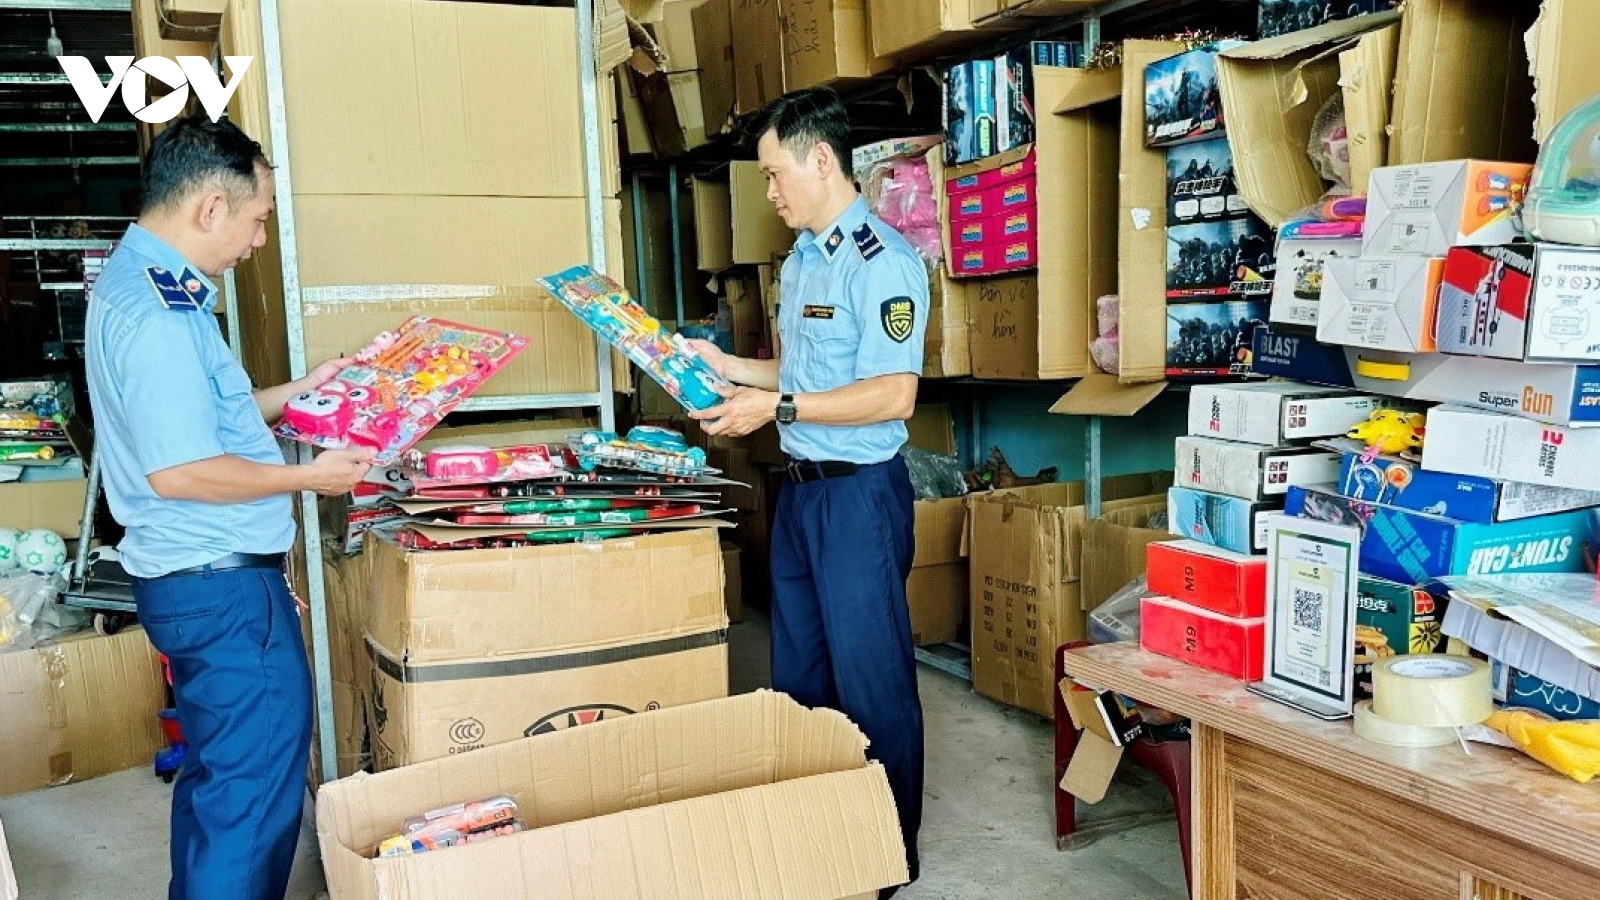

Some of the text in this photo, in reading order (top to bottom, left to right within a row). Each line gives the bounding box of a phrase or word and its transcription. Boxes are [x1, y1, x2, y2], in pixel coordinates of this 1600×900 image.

[891, 302, 911, 311] DMS
[1260, 334, 1299, 359] BLAST
[1479, 391, 1519, 407] Super
[1522, 385, 1553, 416] Gun
[1467, 547, 1507, 576] CAR
[1509, 535, 1573, 569] STUNT
[1184, 566, 1195, 592] M9
[1185, 626, 1197, 653] M9
